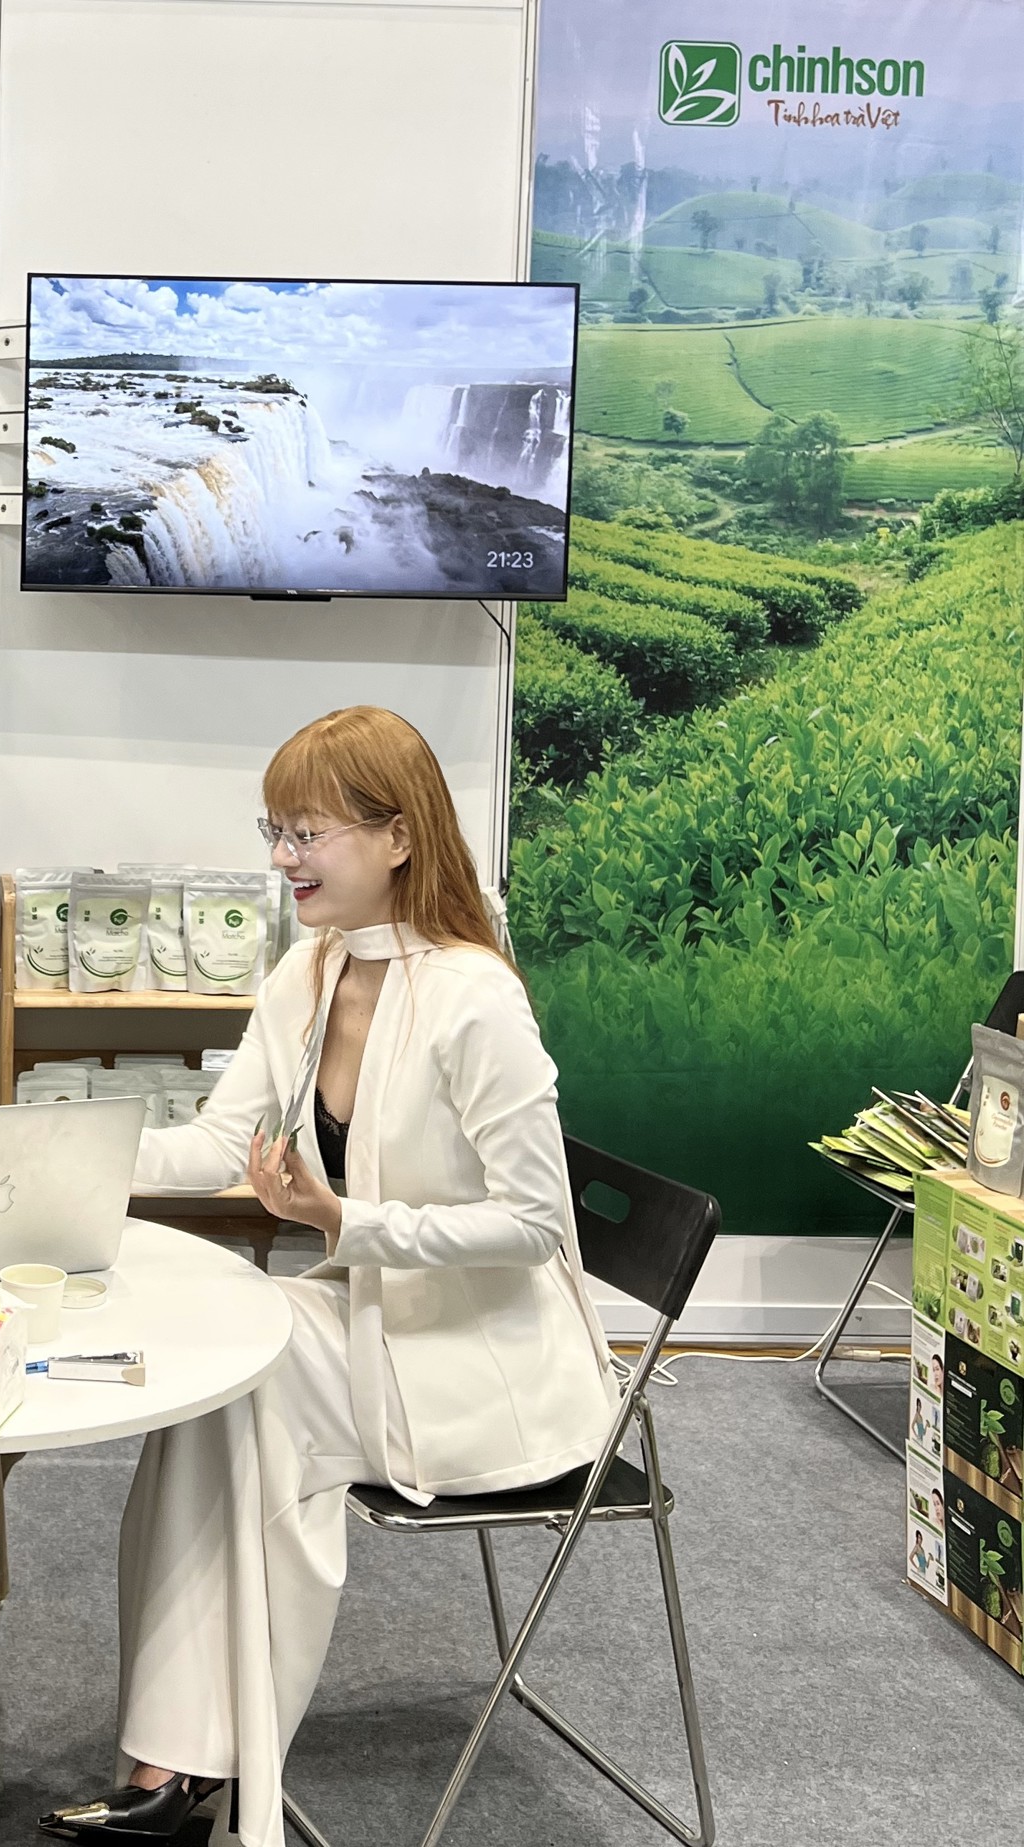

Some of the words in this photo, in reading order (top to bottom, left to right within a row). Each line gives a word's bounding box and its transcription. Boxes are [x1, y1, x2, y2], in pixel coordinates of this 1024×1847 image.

[748, 44, 924, 97] chinhson
[767, 100, 810, 126] Tinh
[810, 102, 840, 126] hoa
[843, 108, 866, 127] trà
[487, 551, 533, 569] 21:23
